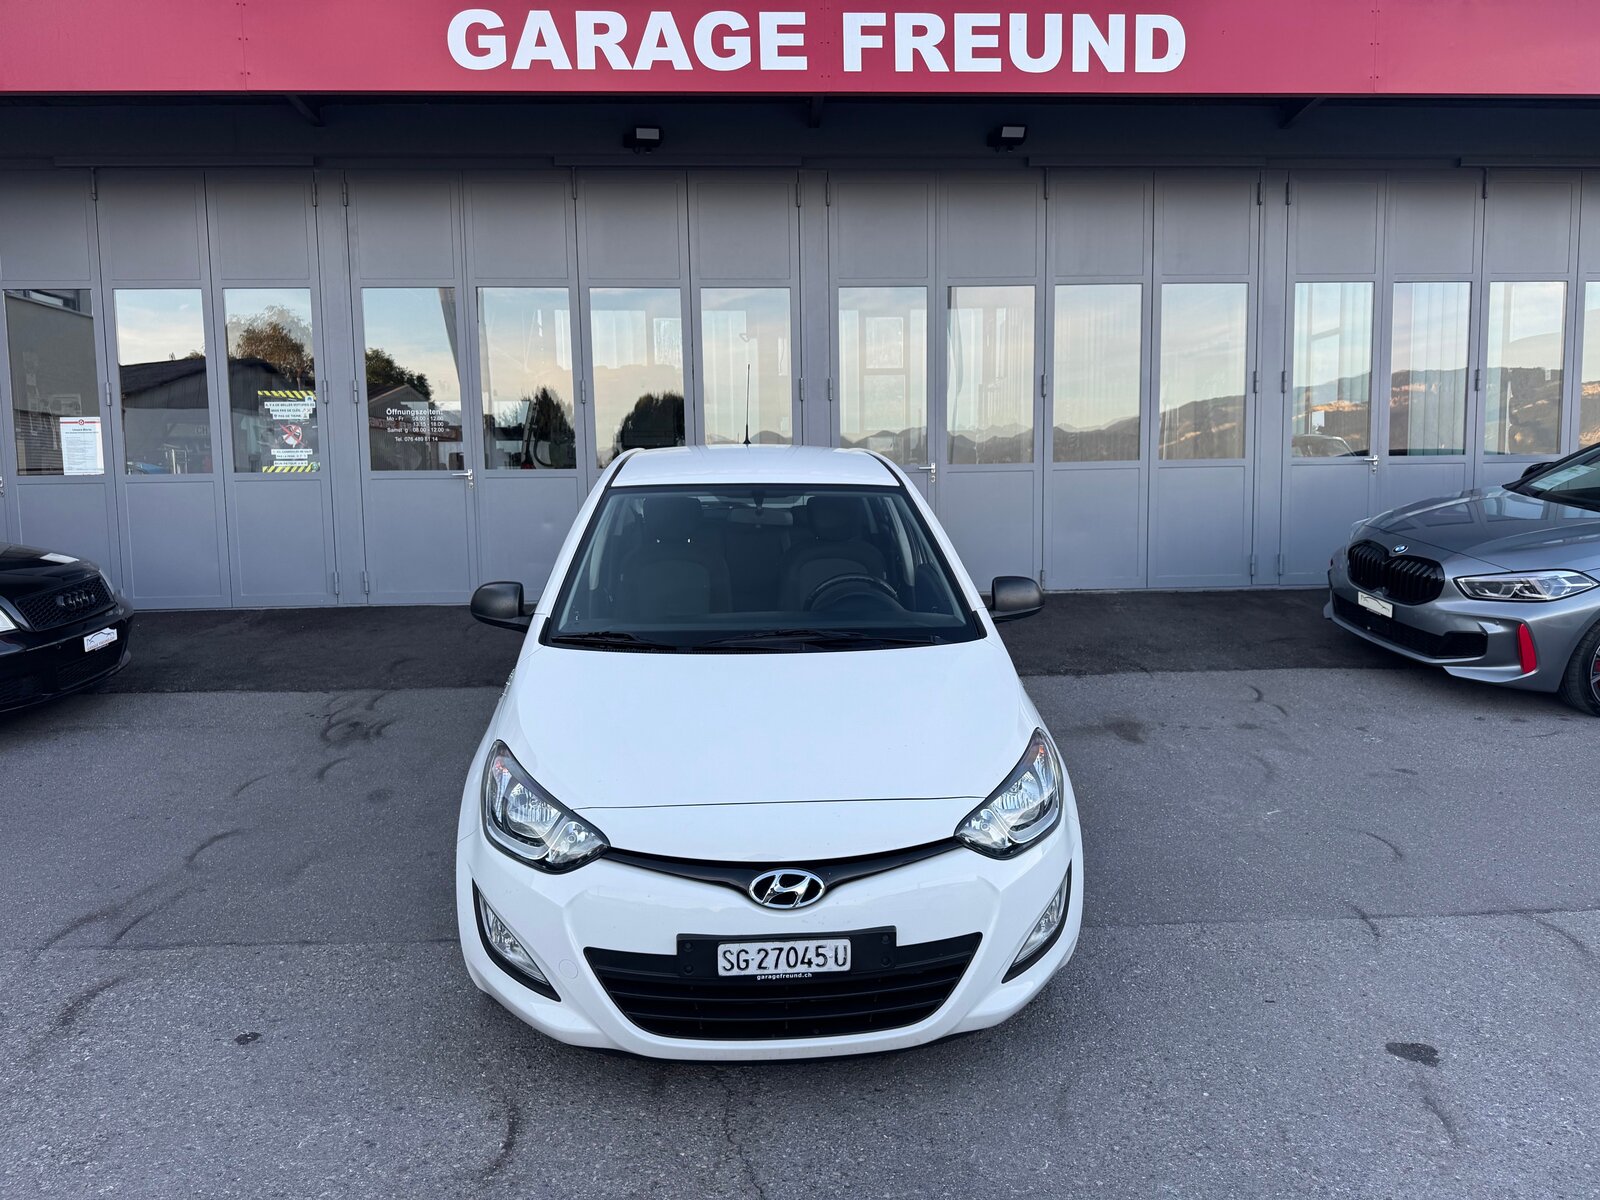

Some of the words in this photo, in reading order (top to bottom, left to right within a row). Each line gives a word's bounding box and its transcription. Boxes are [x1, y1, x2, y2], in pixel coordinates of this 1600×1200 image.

[447, 8, 808, 71] GARAGE
[842, 11, 1187, 74] FREUND
[756, 972, 813, 980] garagefreund.ch
